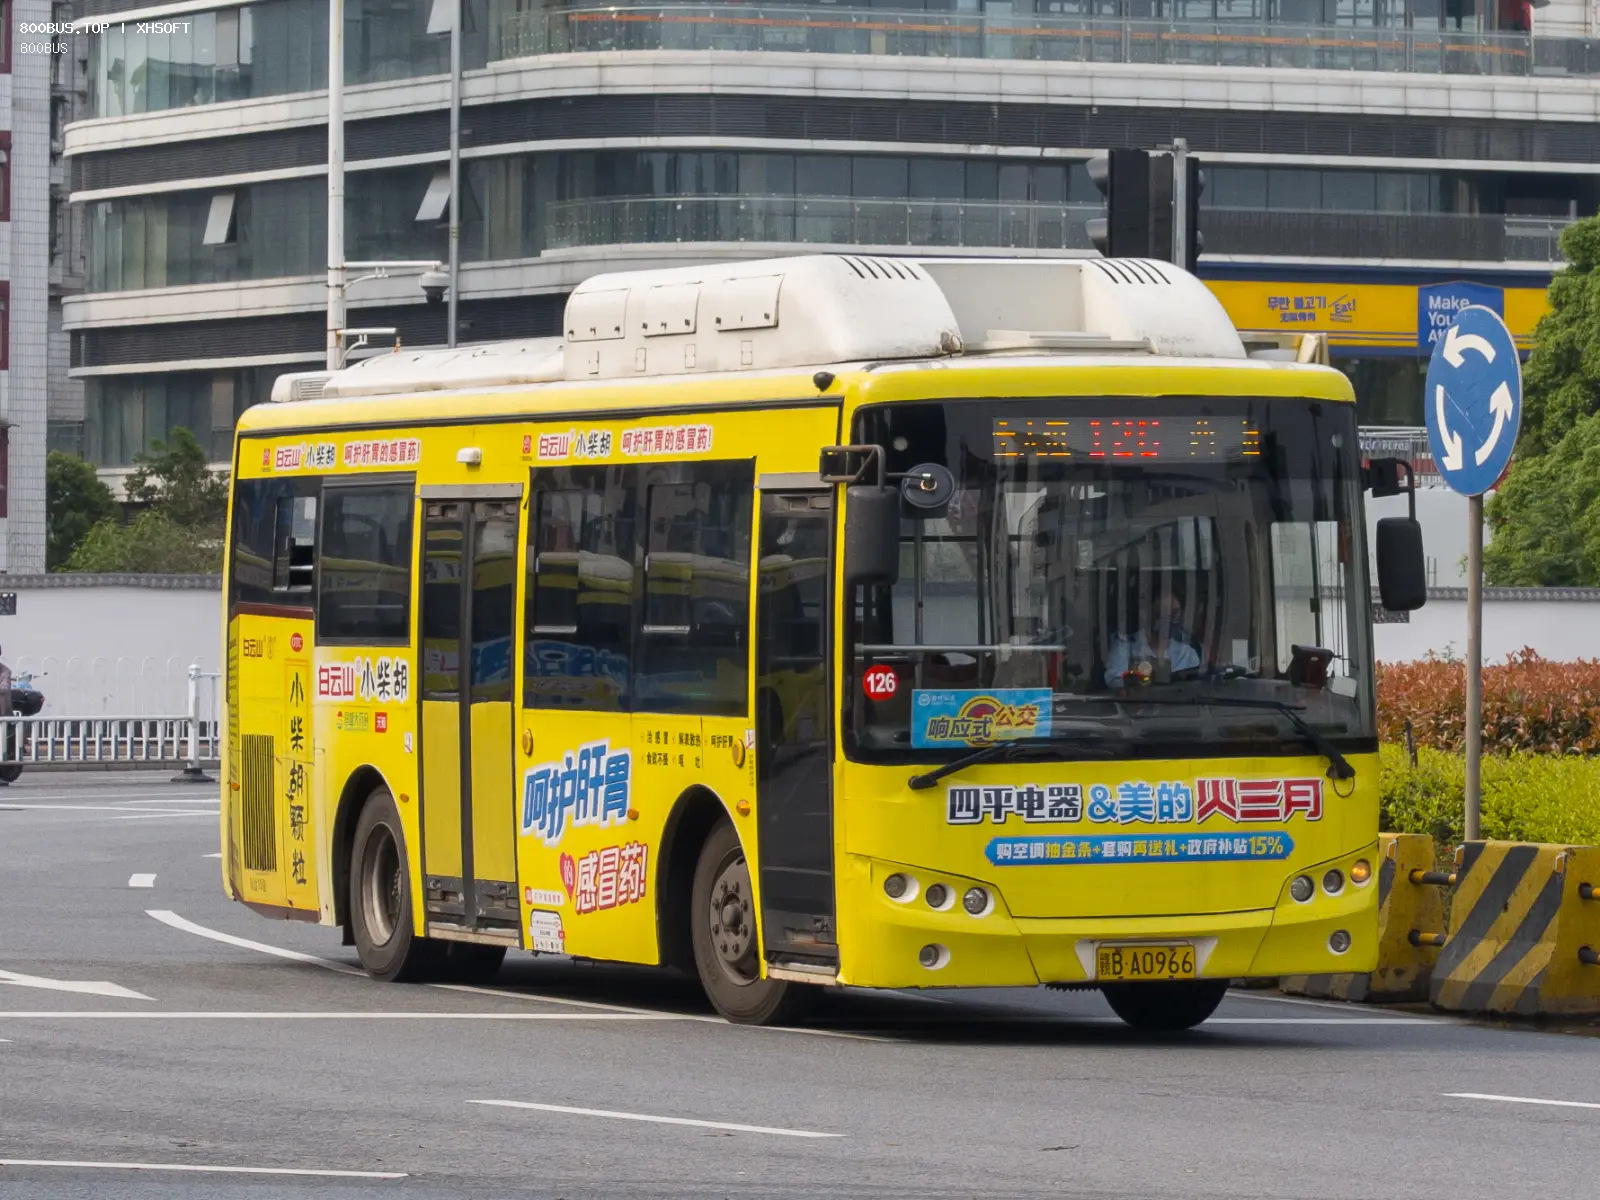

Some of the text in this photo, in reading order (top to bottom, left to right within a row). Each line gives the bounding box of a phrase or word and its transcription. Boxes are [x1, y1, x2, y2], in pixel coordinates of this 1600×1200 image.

[1428, 295, 1470, 310] Make
[539, 435, 569, 457] 白云山
[318, 661, 407, 699] 白云山 小柴胡
[866, 672, 897, 693] 126
[522, 743, 631, 840] 呵护肝胃
